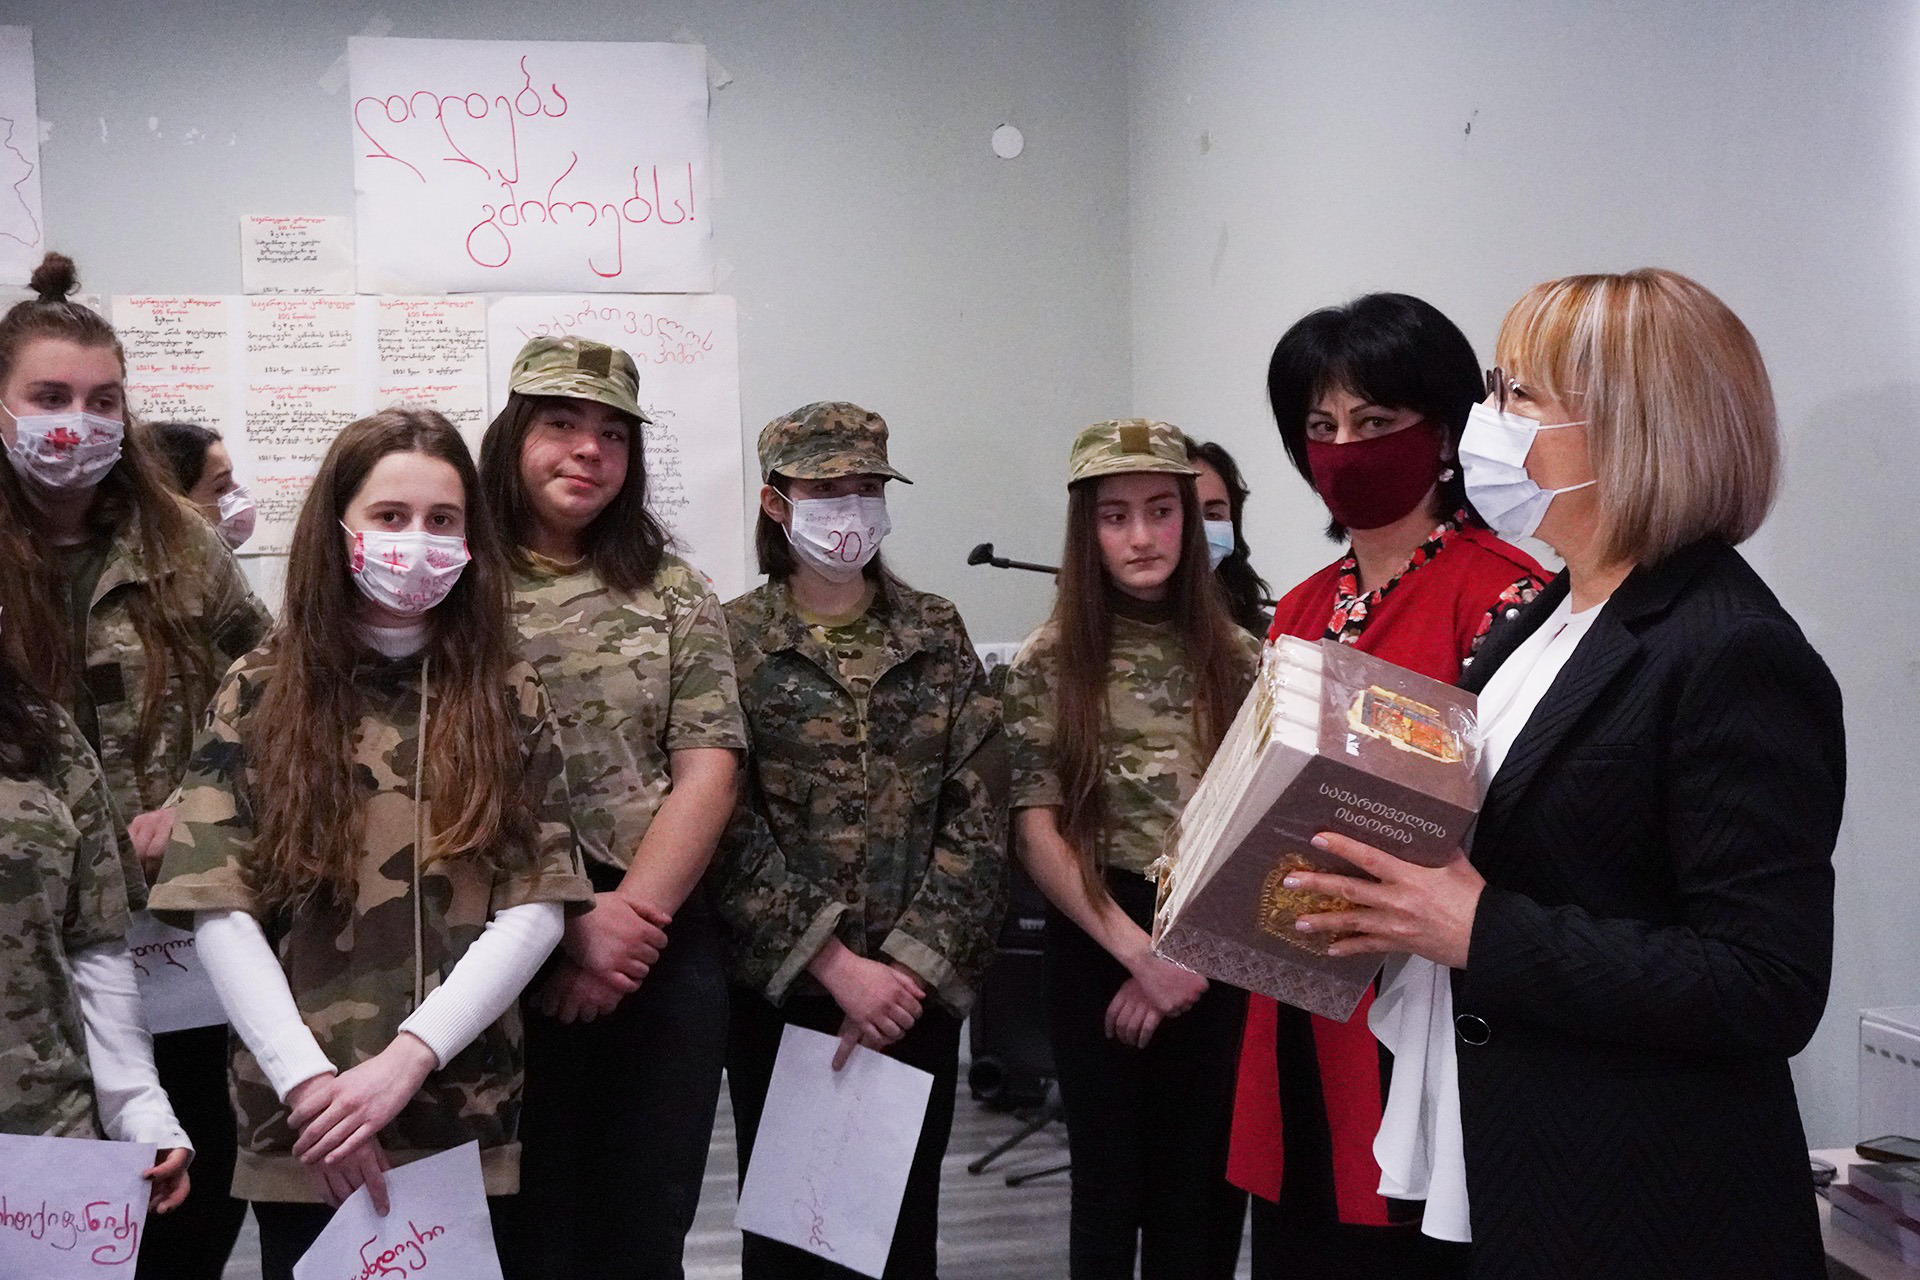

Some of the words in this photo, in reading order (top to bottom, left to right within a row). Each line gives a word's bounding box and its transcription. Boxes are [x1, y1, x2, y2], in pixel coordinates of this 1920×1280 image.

[354, 55, 568, 184] დიდება
[466, 151, 695, 278] გმირებს!
[1319, 782, 1447, 838] საქართველოს
[1334, 807, 1414, 844] ისტორია
